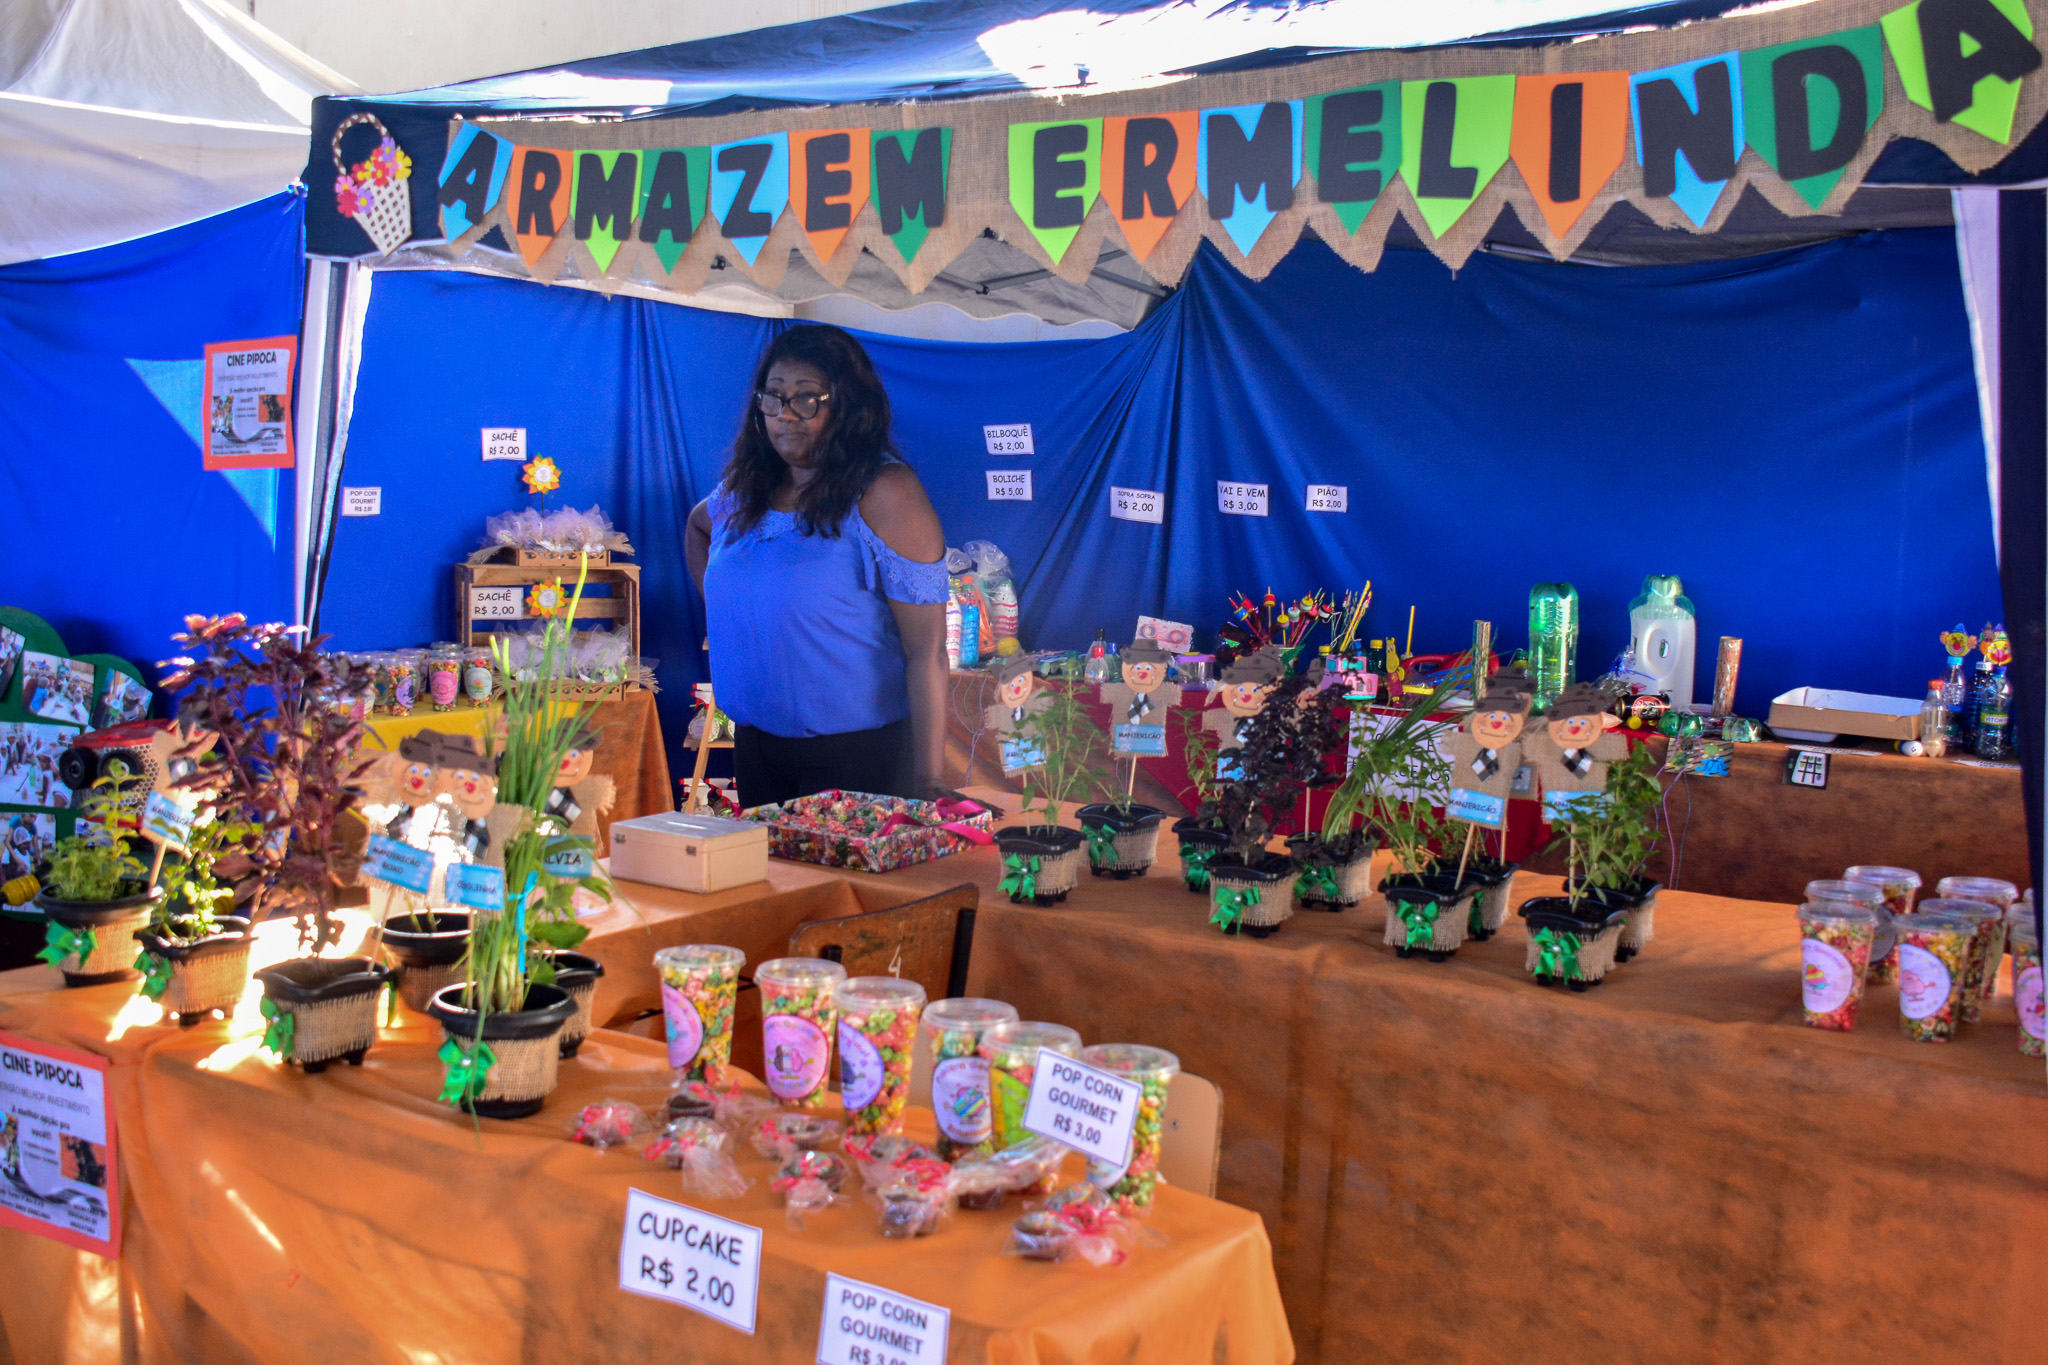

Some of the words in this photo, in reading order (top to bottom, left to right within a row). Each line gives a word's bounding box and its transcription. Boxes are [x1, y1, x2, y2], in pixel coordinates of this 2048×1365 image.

[439, 126, 946, 243] ARMAZEM
[1032, 0, 2043, 231] ERMELINDA
[226, 353, 245, 367] CINE
[246, 351, 277, 366] PIPOCA
[491, 430, 518, 442] SACHÊ
[987, 425, 1028, 438] BILBOQUÊ
[489, 447, 497, 456] R$
[499, 446, 519, 456] 2,00
[993, 442, 1003, 451] R$
[1006, 441, 1024, 451] 2,00
[993, 474, 1025, 483] BOLICHE
[995, 487, 1005, 496] R$
[1008, 487, 1024, 497] 5,00
[1117, 490, 1134, 498] SOPRA
[1136, 492, 1155, 500] SOPRA
[1219, 485, 1233, 495] VAI
[1237, 487, 1243, 496] E
[1246, 488, 1266, 498] VEM
[1317, 487, 1338, 497] PIÃO
[1118, 500, 1128, 510] R$
[1132, 502, 1154, 512] 2,00
[1223, 500, 1234, 510] R$
[1238, 501, 1258, 511] 3,00
[1312, 499, 1323, 508] R$
[1326, 500, 1342, 509] 2,00
[477, 589, 512, 601] SACHÊ
[474, 605, 487, 616] R$
[491, 606, 515, 616] 2,00
[1118, 731, 1162, 740] MANJERICÃO
[1450, 799, 1497, 814] MANJERICÃO
[2, 1051, 32, 1076] CINE
[34, 1059, 84, 1091] PIPOCA
[1052, 1062, 1082, 1084] POP
[1084, 1075, 1123, 1103] CORN
[1048, 1086, 1118, 1125] GOURMET
[1053, 1113, 1073, 1133] R$
[1074, 1121, 1102, 1144] 3,00
[639, 1211, 743, 1267] CUPCAKE
[640, 1255, 674, 1289] R$
[686, 1267, 735, 1308] 2,00
[841, 1288, 877, 1312] POP
[881, 1301, 928, 1331] CORN
[839, 1315, 924, 1356] GOURMET
[850, 1345, 871, 1365] R$
